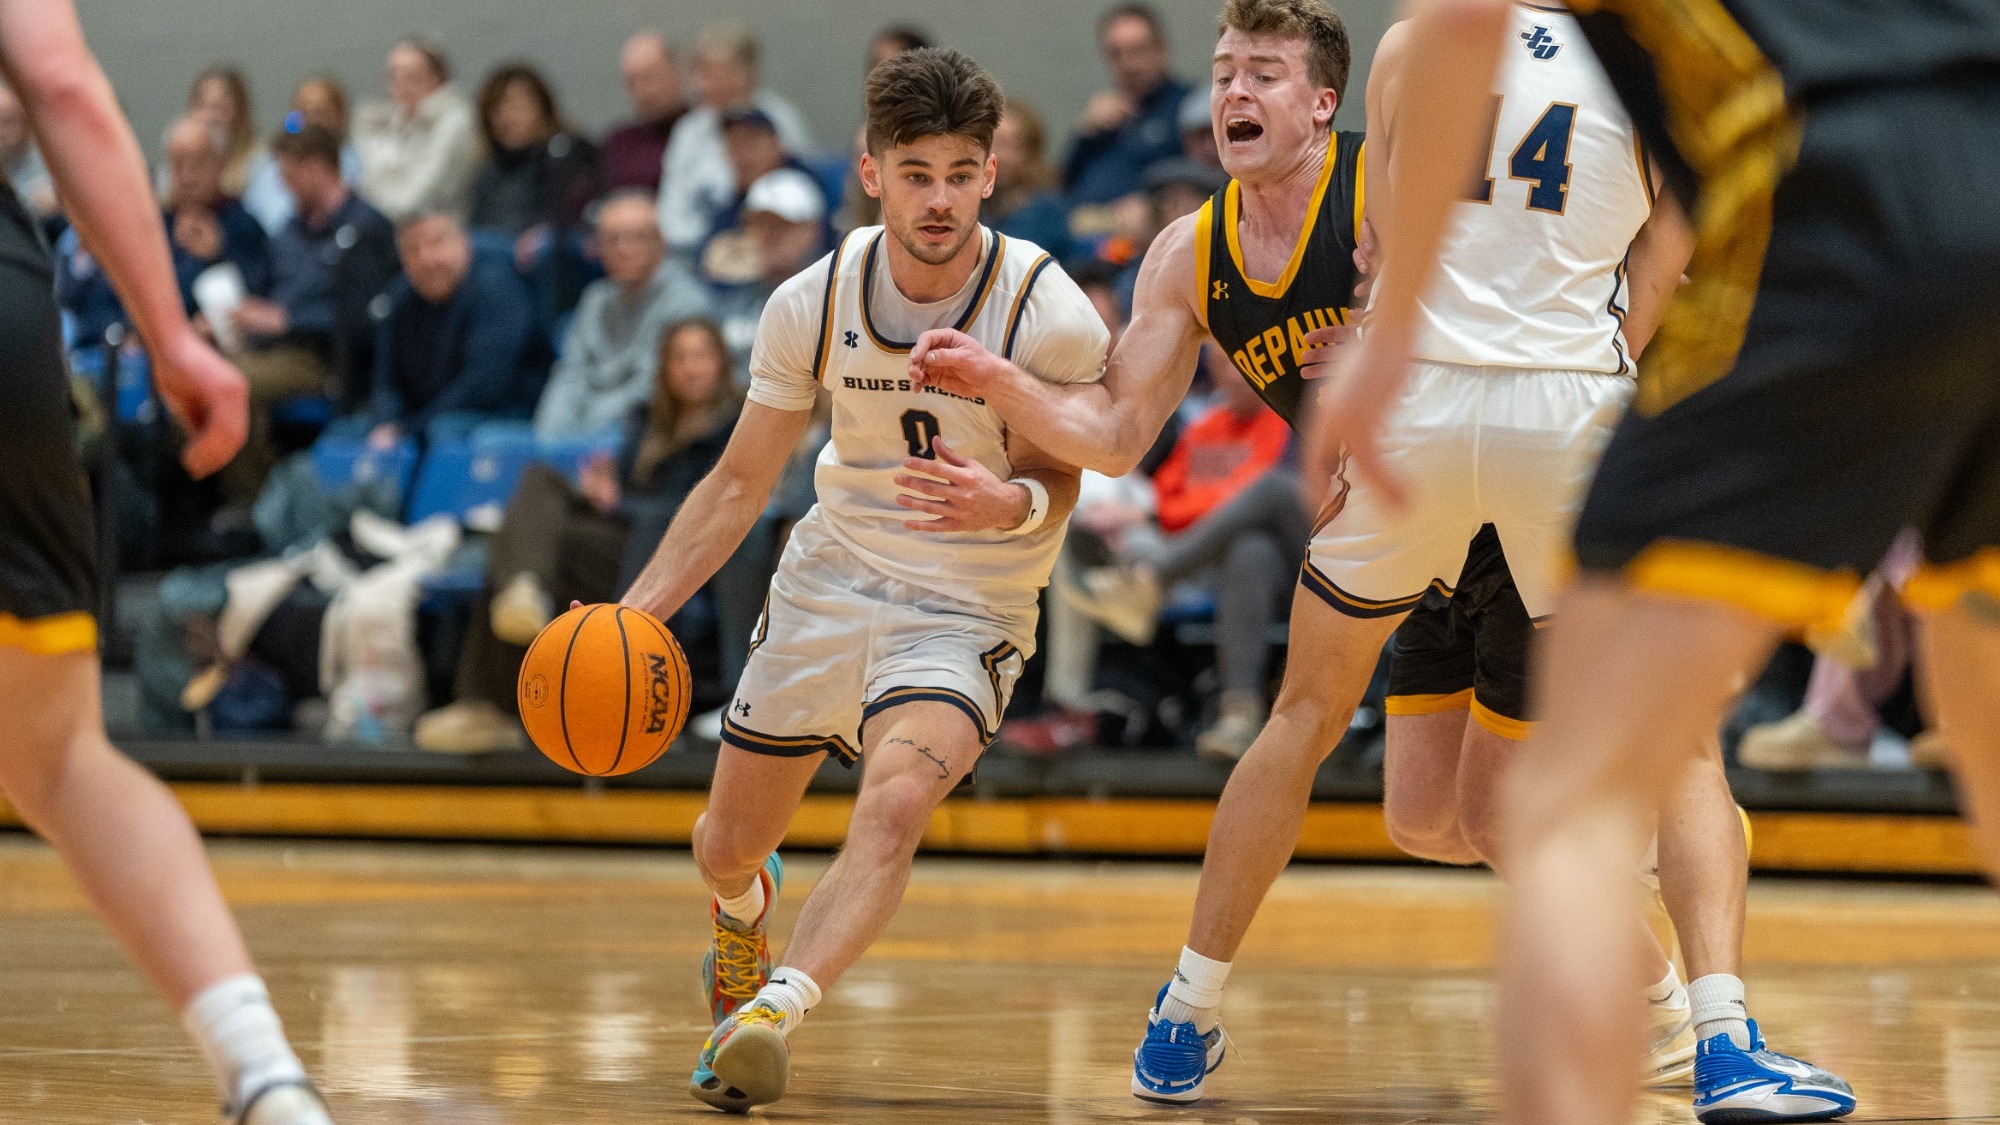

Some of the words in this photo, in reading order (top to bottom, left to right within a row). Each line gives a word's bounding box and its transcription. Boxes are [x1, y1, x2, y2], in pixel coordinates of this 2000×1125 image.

[1518, 24, 1563, 61] JCU
[1232, 307, 1349, 391] DEPA
[842, 376, 894, 391] BLUE
[899, 407, 942, 460] 0
[646, 652, 669, 734] NCAA
